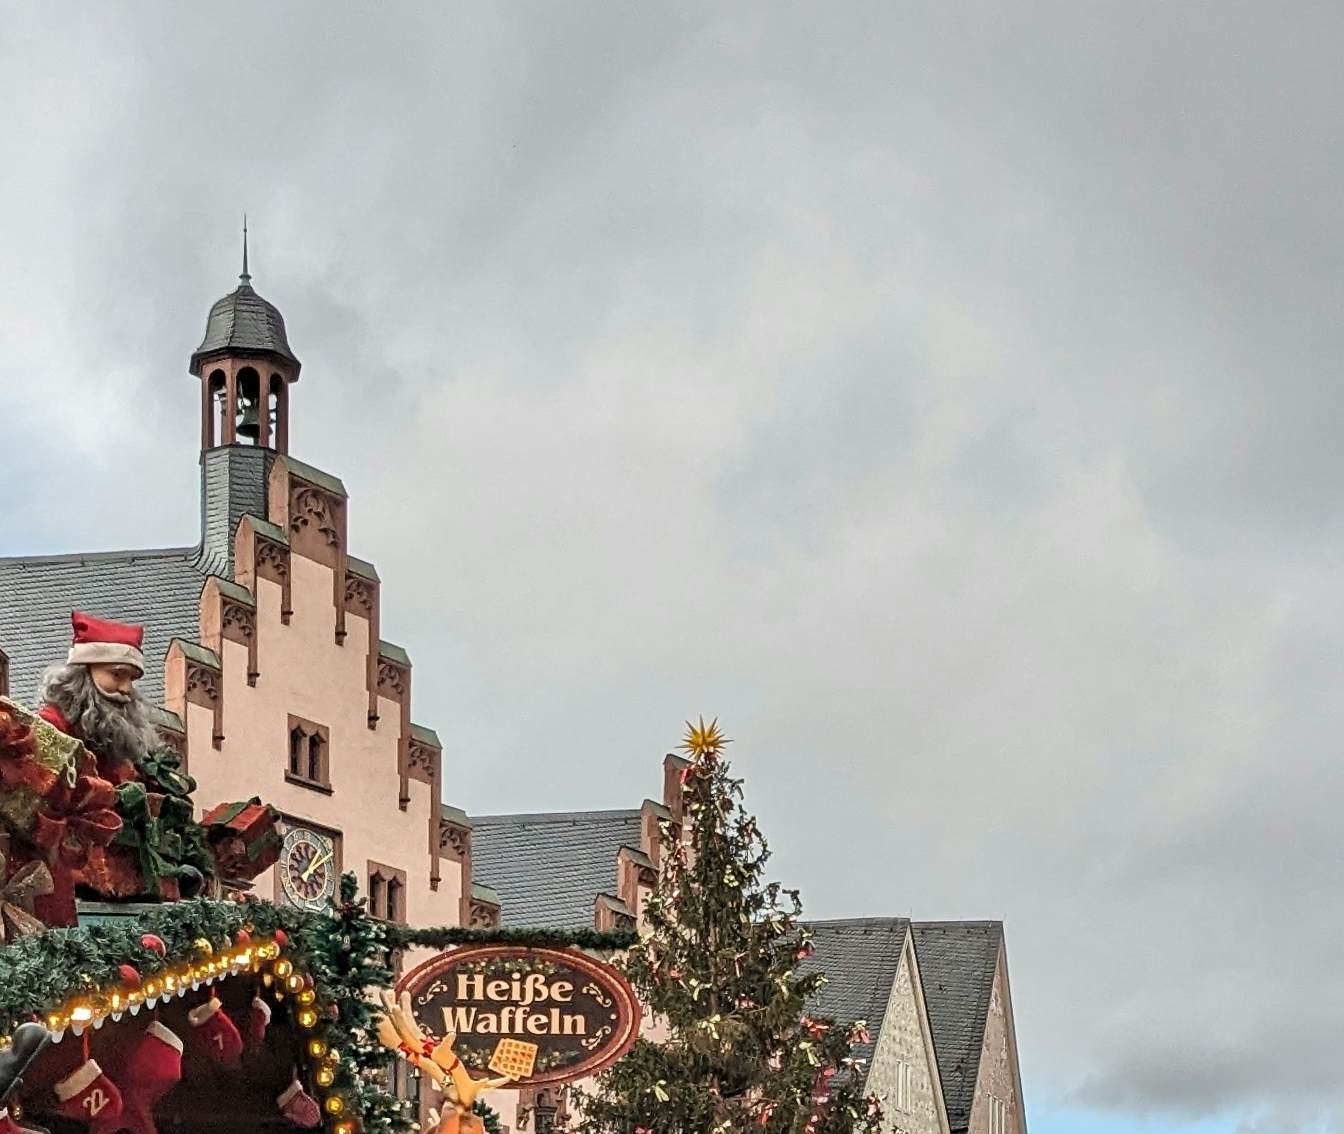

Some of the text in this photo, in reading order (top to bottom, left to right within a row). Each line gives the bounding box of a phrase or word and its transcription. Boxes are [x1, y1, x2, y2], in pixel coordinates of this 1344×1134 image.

[456, 972, 574, 1005] Heiße
[442, 1007, 587, 1036] Waffeln
[83, 1089, 110, 1116] 22
